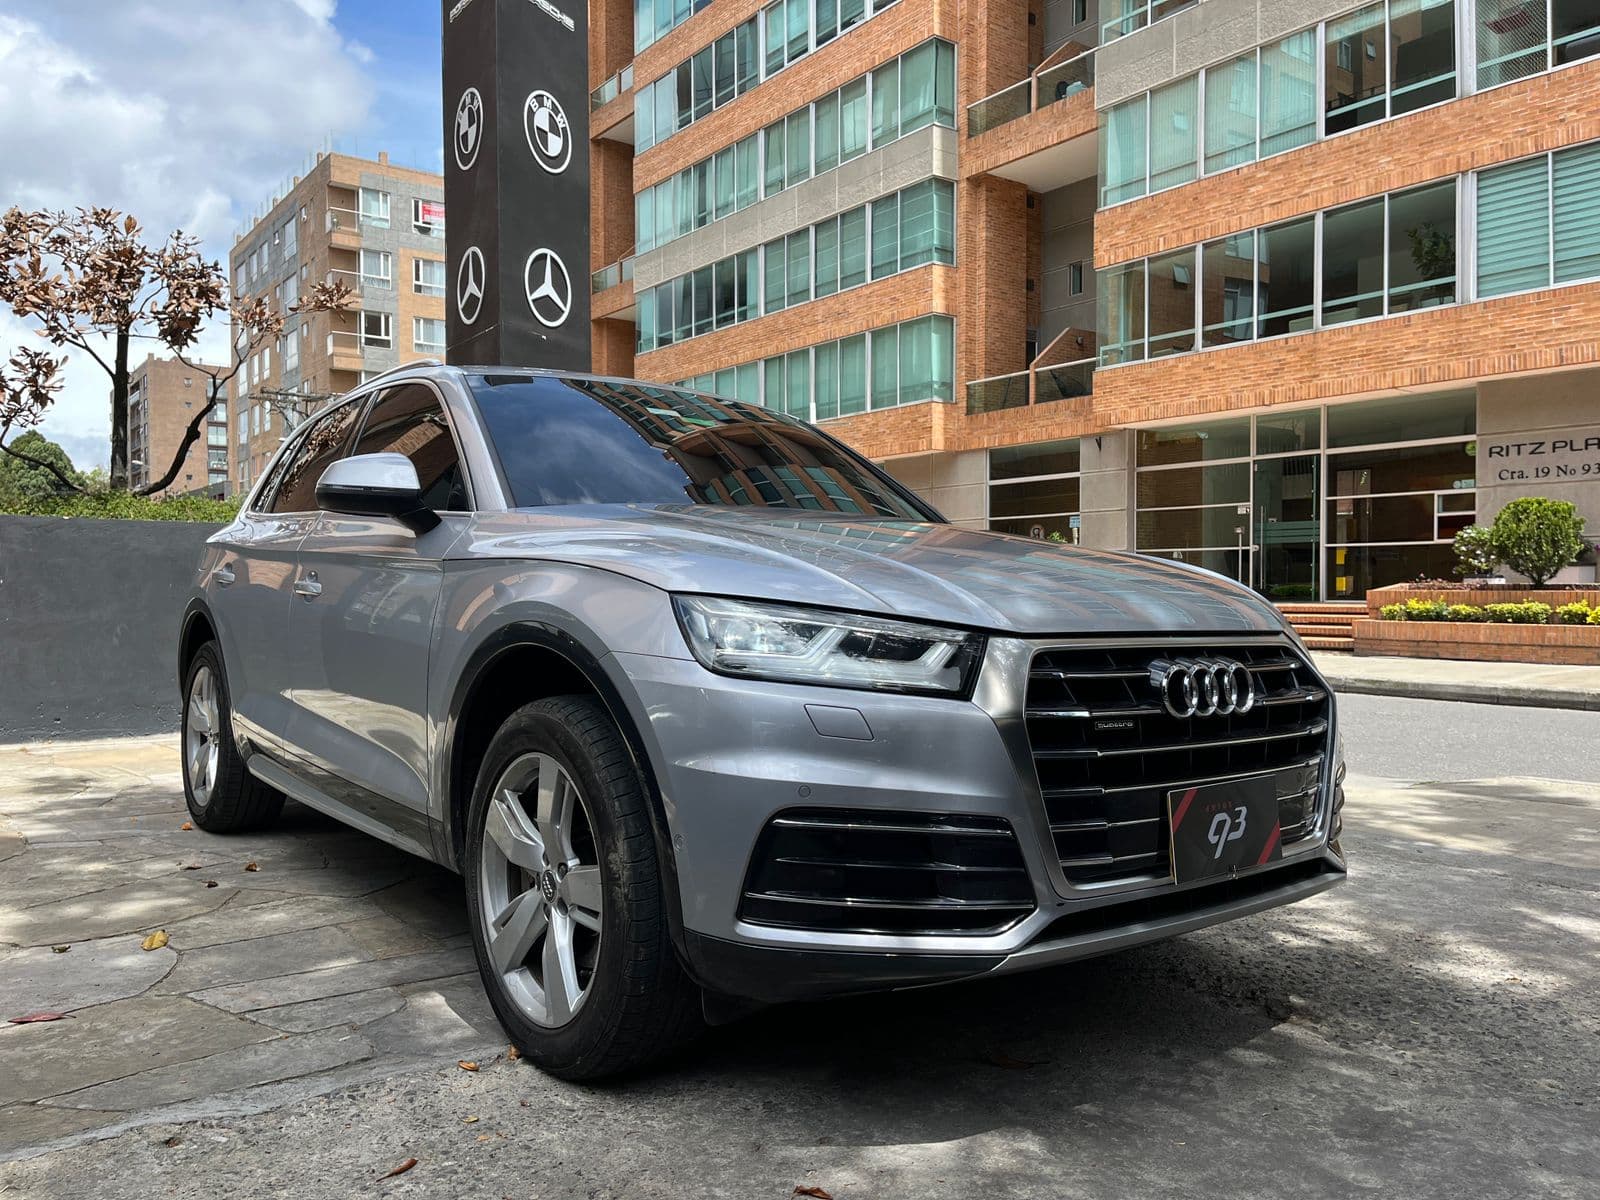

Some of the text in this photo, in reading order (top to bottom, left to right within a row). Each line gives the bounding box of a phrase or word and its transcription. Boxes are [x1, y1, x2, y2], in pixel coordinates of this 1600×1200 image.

[529, 96, 566, 129] BMW
[1489, 442, 1546, 458] RITZ
[1498, 469, 1529, 480] Cra.
[1534, 466, 1551, 478] 19
